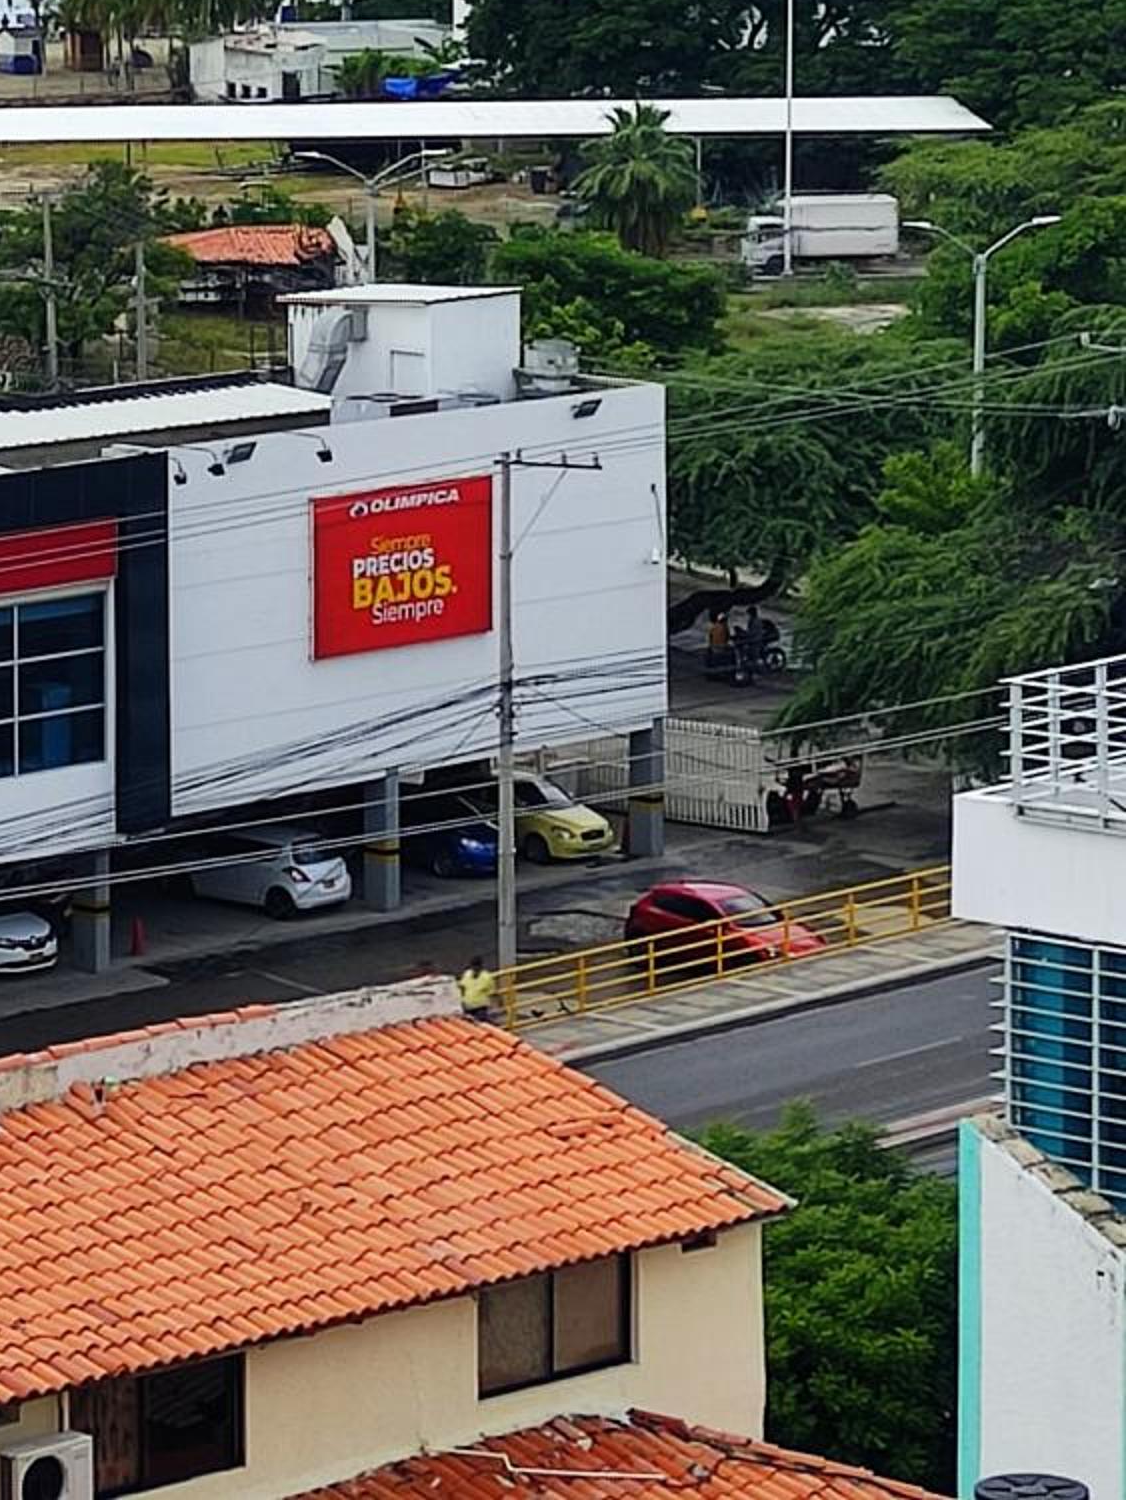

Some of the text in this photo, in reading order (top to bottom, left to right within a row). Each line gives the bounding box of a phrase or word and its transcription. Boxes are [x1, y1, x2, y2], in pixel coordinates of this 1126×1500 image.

[370, 488, 460, 514] OLIMPICA
[371, 533, 431, 554] Siempre
[353, 548, 435, 578] PRECIOS
[353, 565, 458, 609] BAJOS.
[372, 596, 444, 624] Siempre
